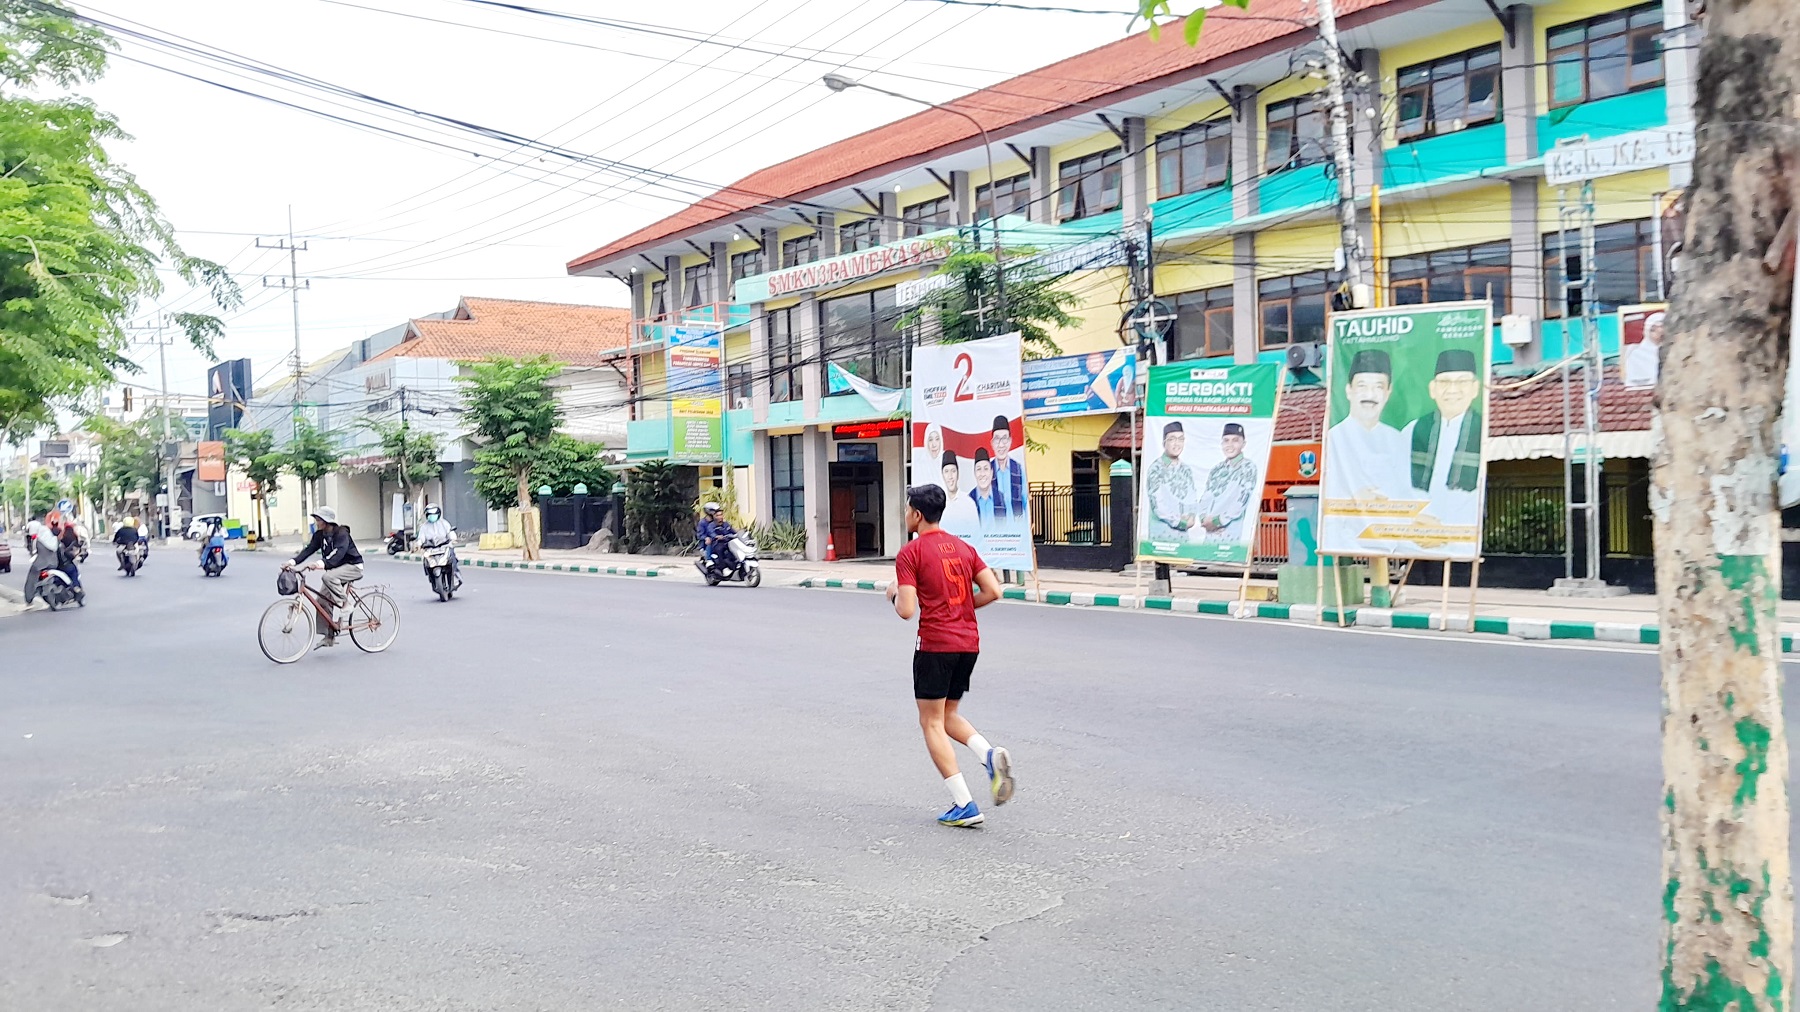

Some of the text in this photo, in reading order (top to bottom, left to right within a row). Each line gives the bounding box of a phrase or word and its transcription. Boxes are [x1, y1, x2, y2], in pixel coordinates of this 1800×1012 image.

[768, 266, 816, 295] SMKN
[819, 265, 827, 285] 3
[1336, 317, 1414, 337] TAUHID
[954, 352, 974, 402] 2
[1166, 382, 1253, 396] BERBAKTI
[1231, 405, 1248, 413] BARU
[941, 557, 967, 606] 5
